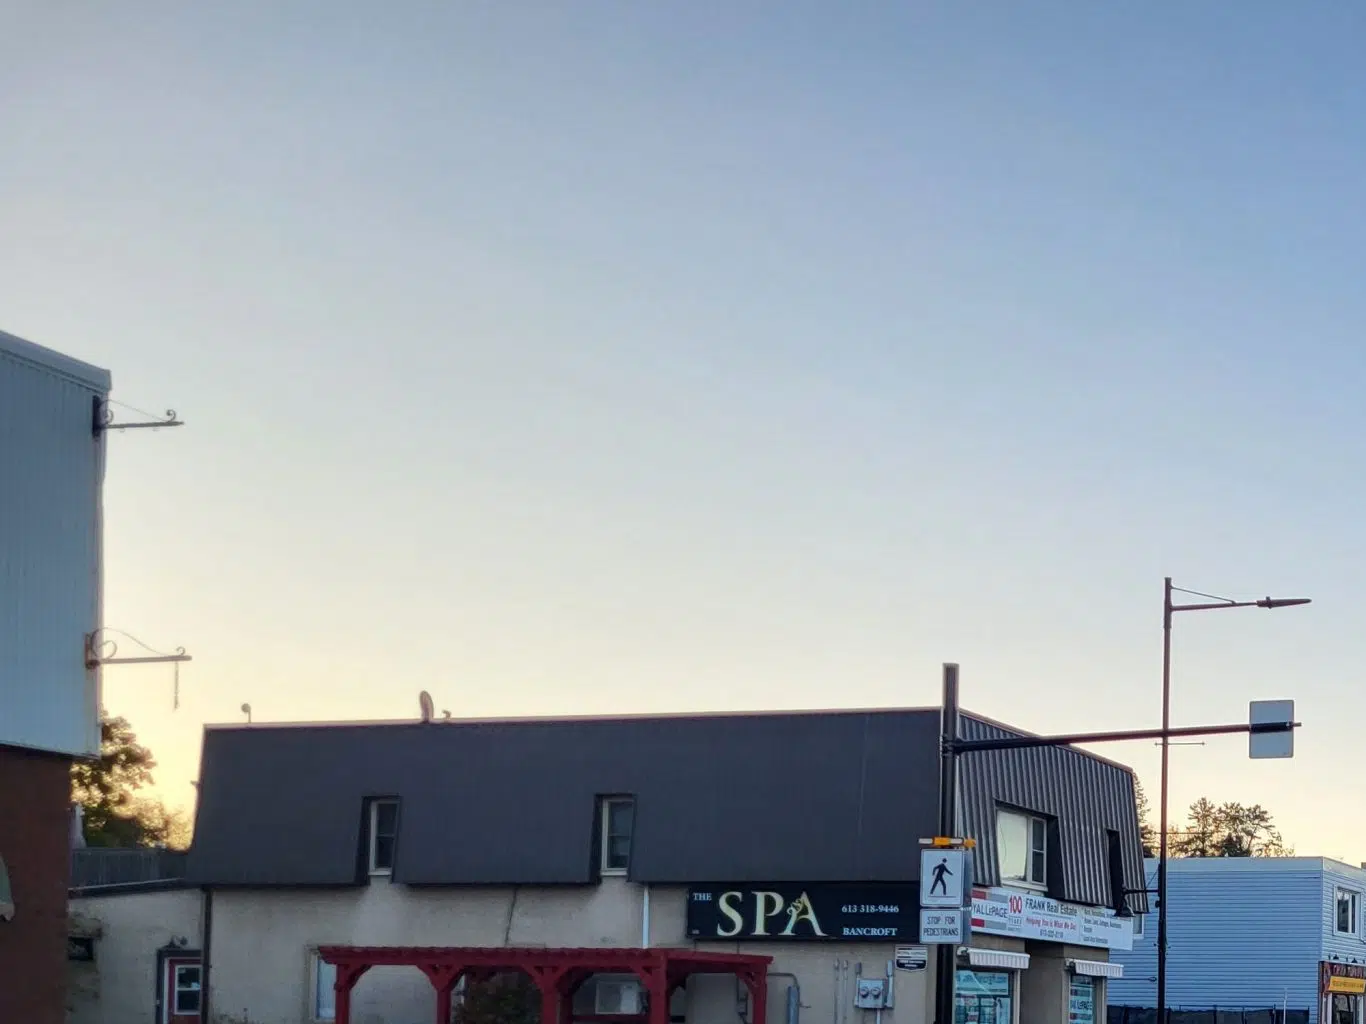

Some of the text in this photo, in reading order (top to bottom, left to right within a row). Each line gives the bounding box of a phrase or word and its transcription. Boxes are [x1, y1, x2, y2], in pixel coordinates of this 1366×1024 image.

[842, 905, 899, 913] 613 318-9446
[1009, 895, 1022, 914] 100
[1025, 898, 1046, 911] FRANK
[1046, 901, 1059, 913] Real
[1060, 904, 1078, 916] Estate
[693, 891, 828, 936] THE SPA
[927, 916, 955, 925] STOP FOR
[843, 927, 898, 936] BANCROFT
[923, 927, 958, 936] PEDESTRIANS
